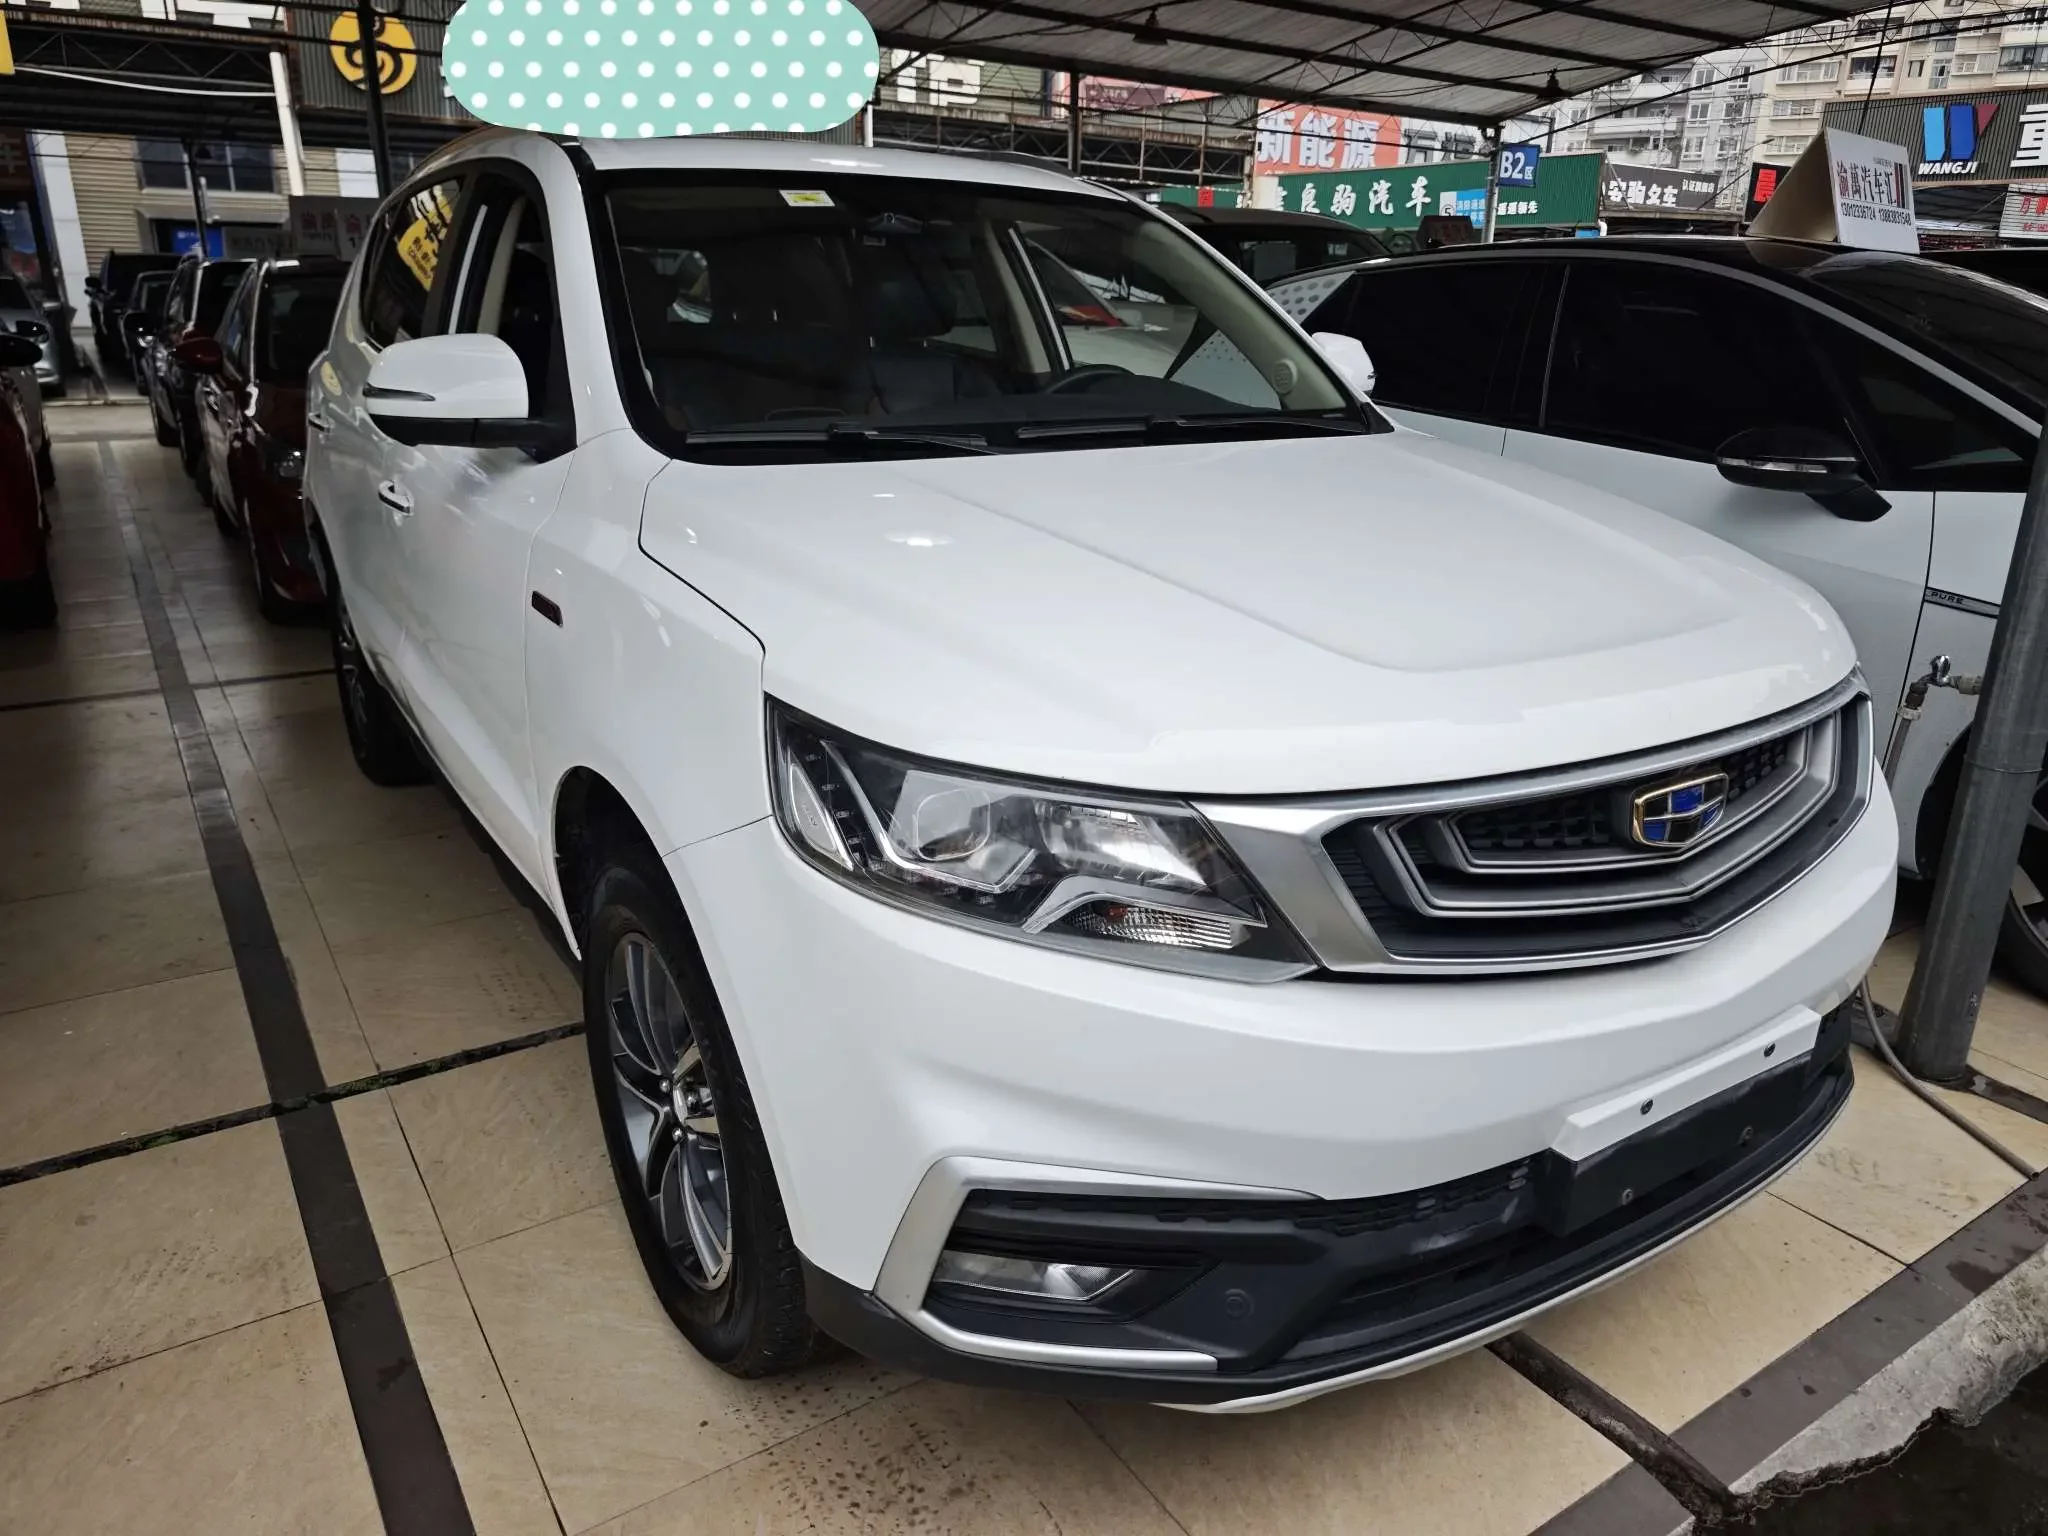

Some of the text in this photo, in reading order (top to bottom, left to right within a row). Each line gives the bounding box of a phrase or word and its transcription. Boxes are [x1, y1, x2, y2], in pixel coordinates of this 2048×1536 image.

[1258, 107, 1380, 169] 新能源
[1500, 151, 1535, 180] B2区
[1918, 161, 1978, 175] WANGJI
